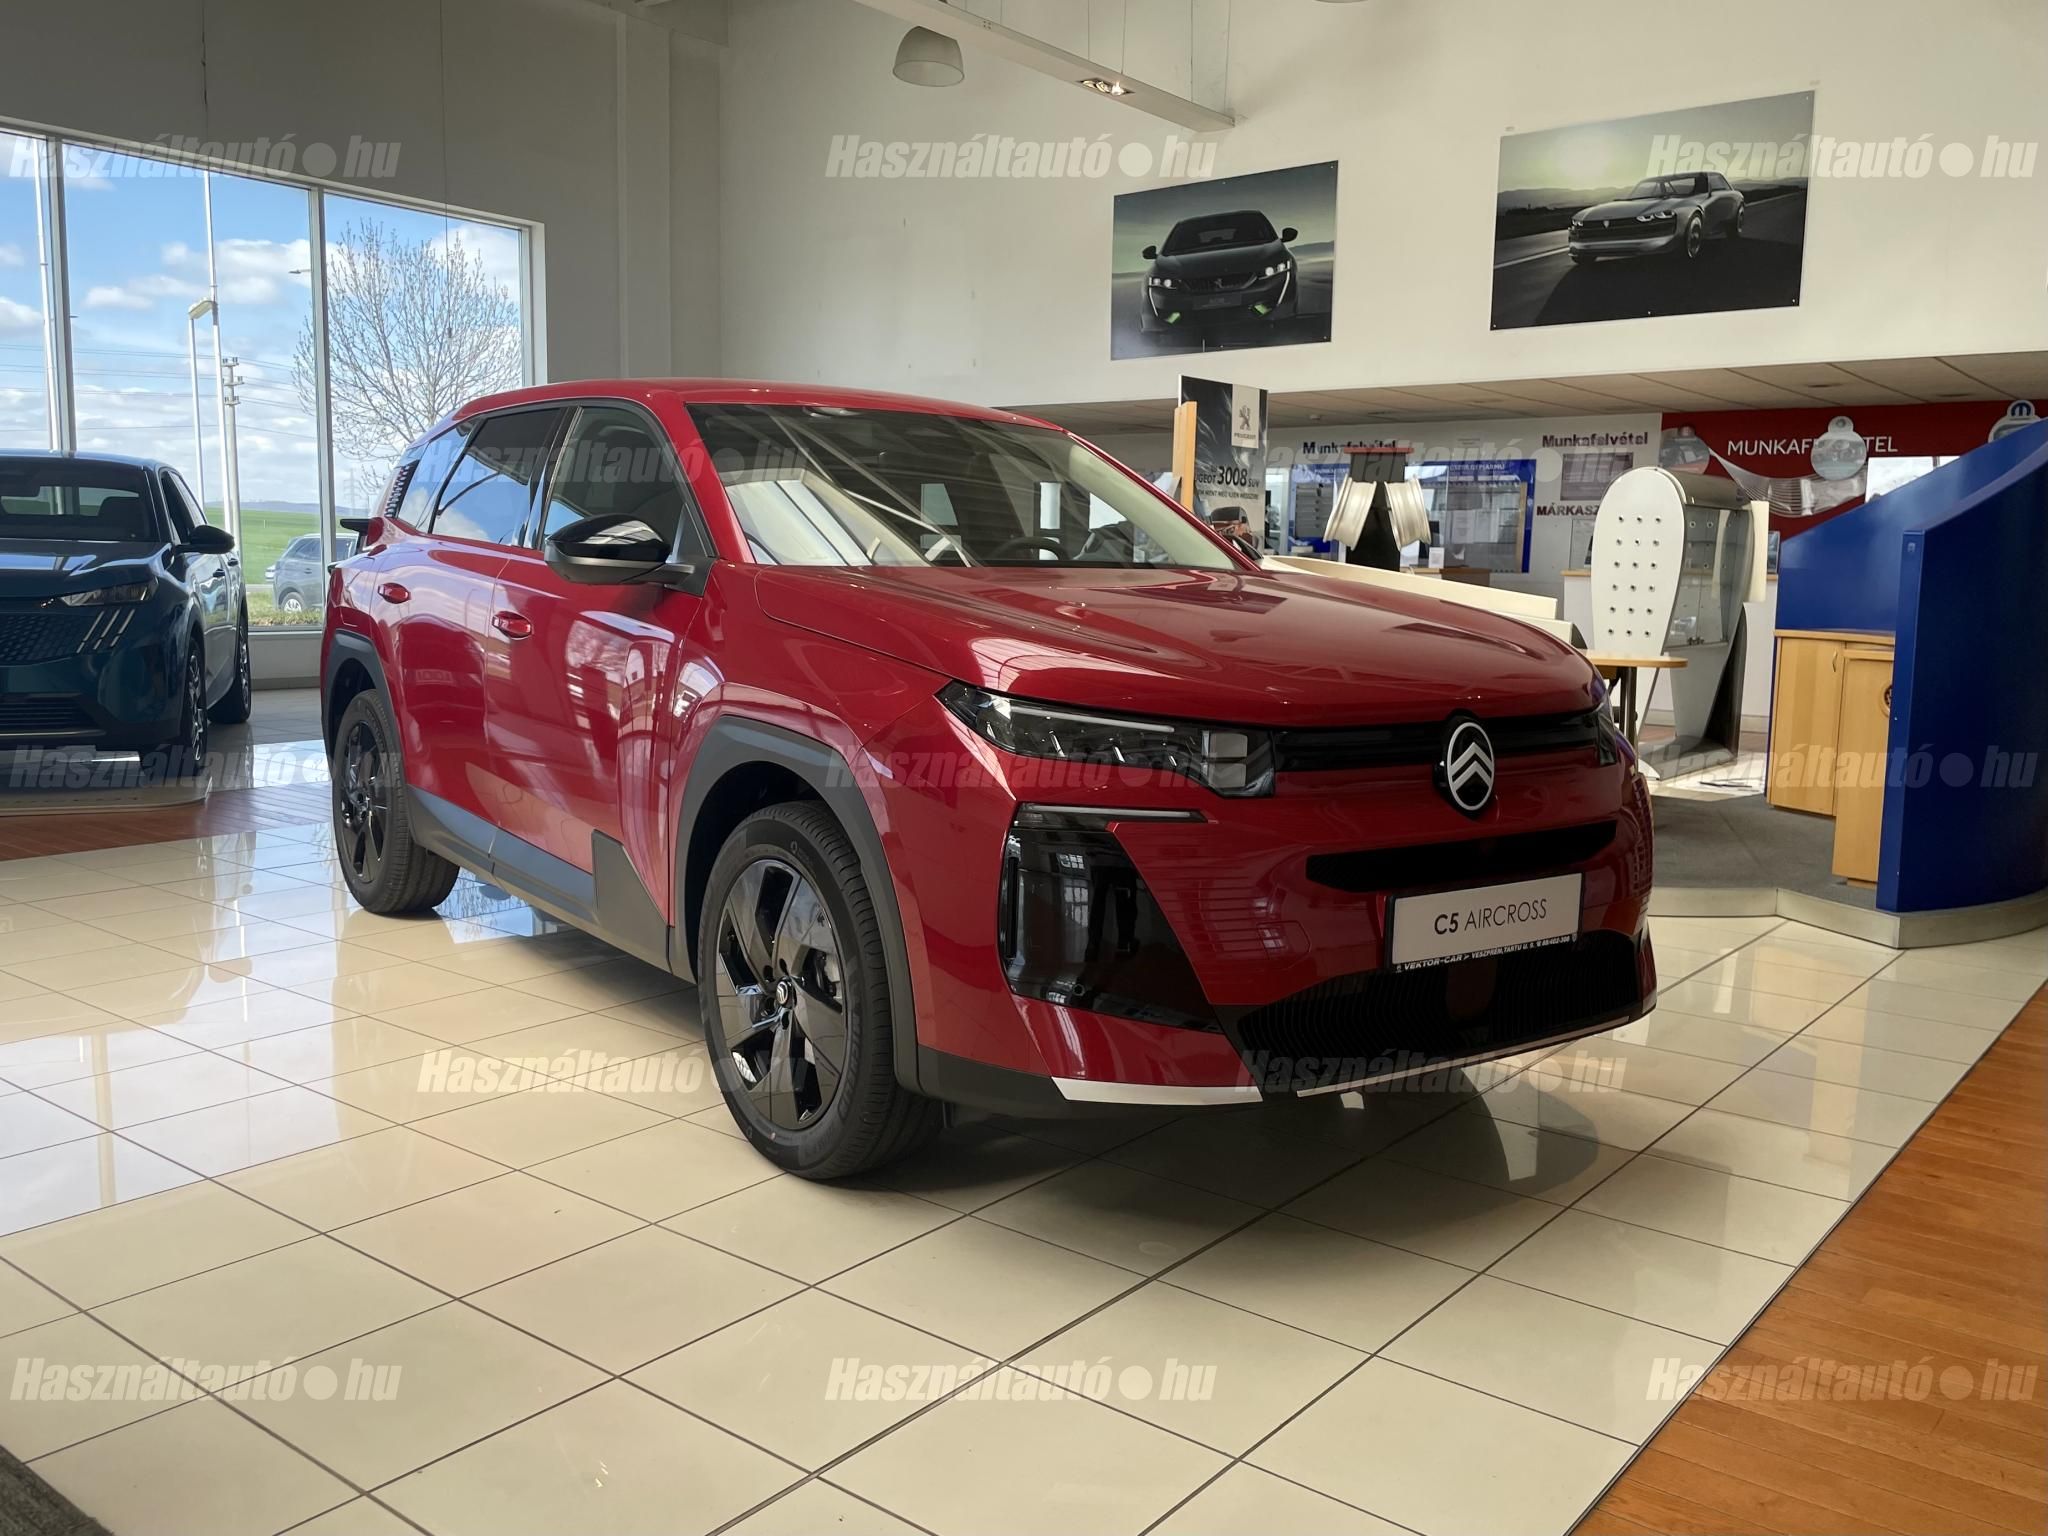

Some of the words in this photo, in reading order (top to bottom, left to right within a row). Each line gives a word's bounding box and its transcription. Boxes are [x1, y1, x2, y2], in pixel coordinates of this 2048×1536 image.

[1542, 432, 1648, 448] Munkafelvétel
[1727, 436, 1898, 456] MUNKAFTEL
[1217, 466, 1248, 486] 3008
[1248, 478, 1259, 488] SUV
[1434, 912, 1459, 935] C5
[1464, 898, 1547, 931] AIRCROSS
[1404, 954, 1463, 970] VEKTOR-CAR
